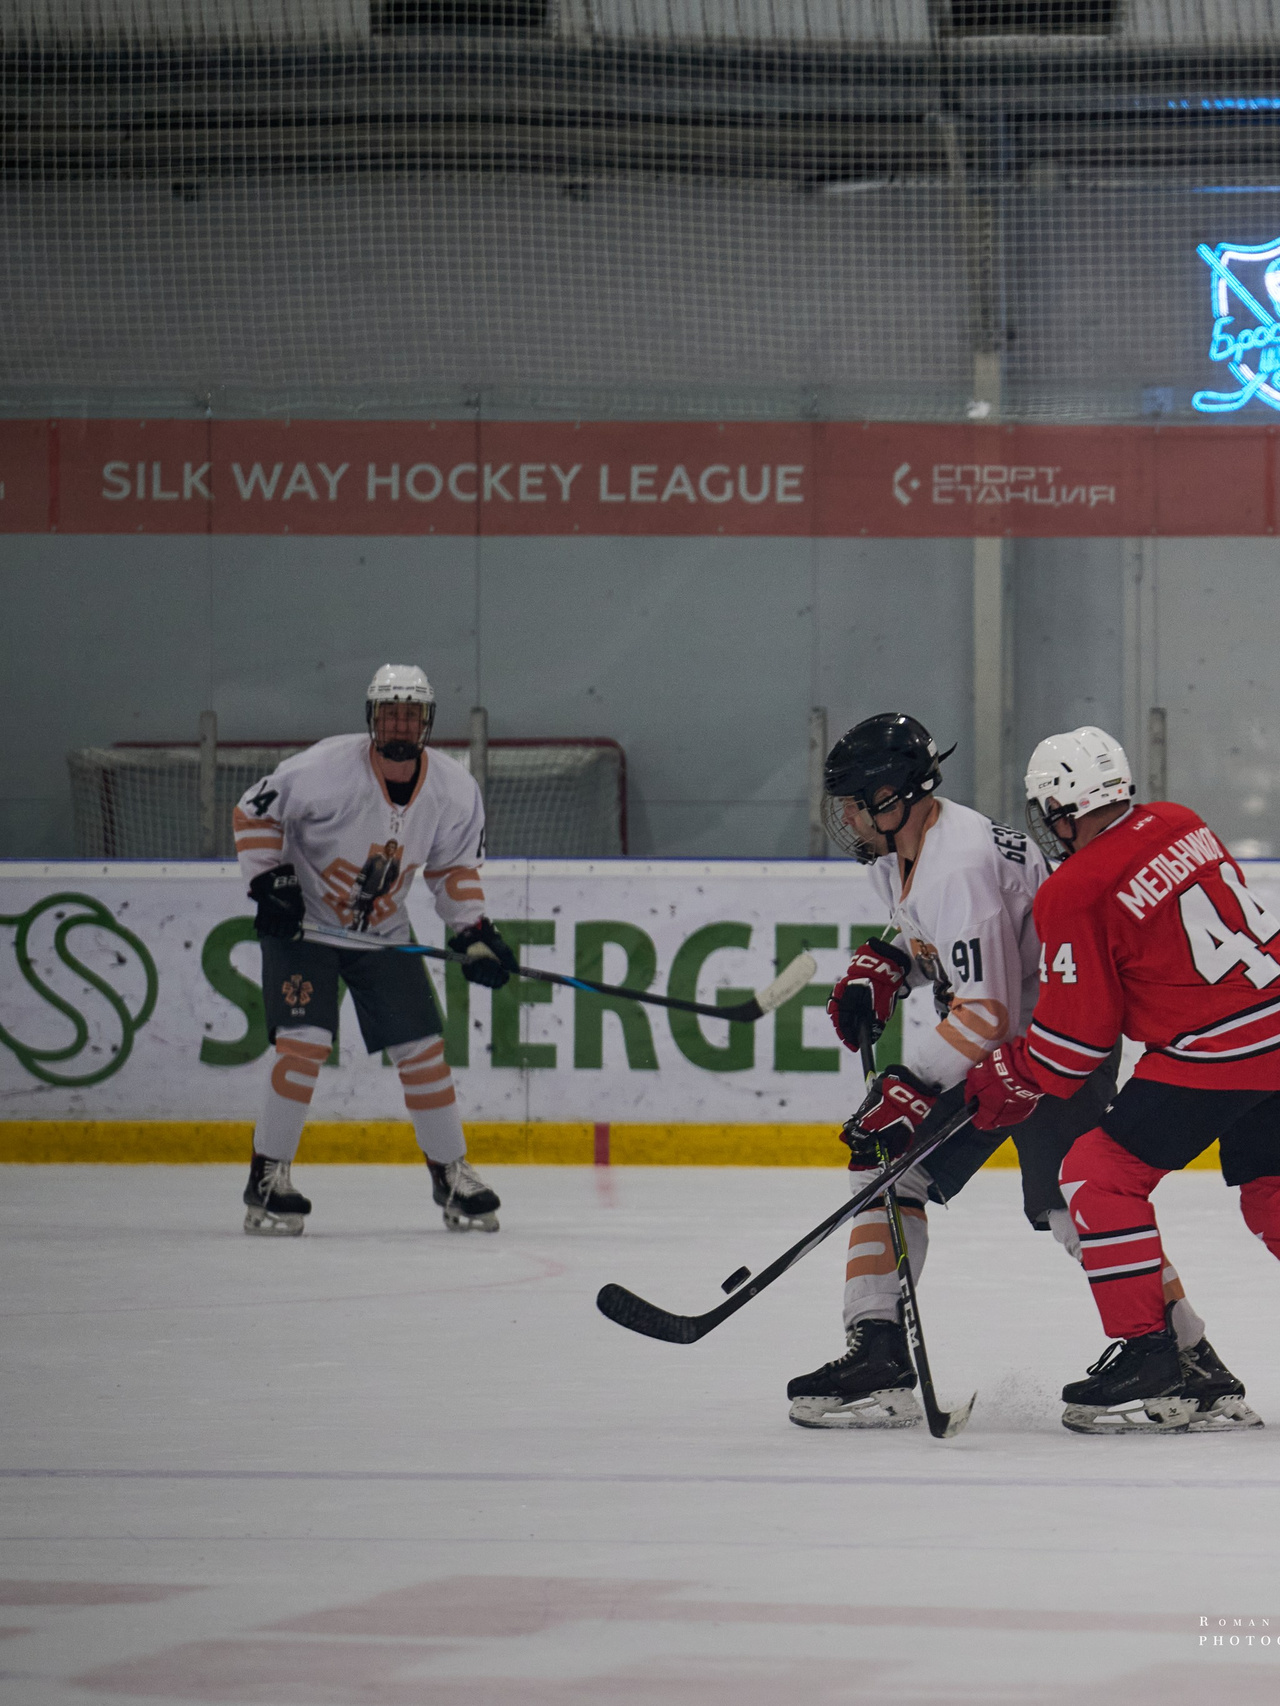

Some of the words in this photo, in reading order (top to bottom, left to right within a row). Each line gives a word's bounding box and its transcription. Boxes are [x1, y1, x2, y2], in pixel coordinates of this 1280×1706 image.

[102, 461, 214, 501] SILK
[231, 462, 350, 501] WAY
[366, 462, 583, 502] HOCKEY
[600, 464, 805, 503] LEAGUE
[932, 464, 1061, 484] СПОРТ
[932, 484, 1116, 508] СТАНЦИЯ
[991, 820, 1027, 866] БЕЗ
[952, 938, 983, 982] 91
[888, 1085, 932, 1119] CC
